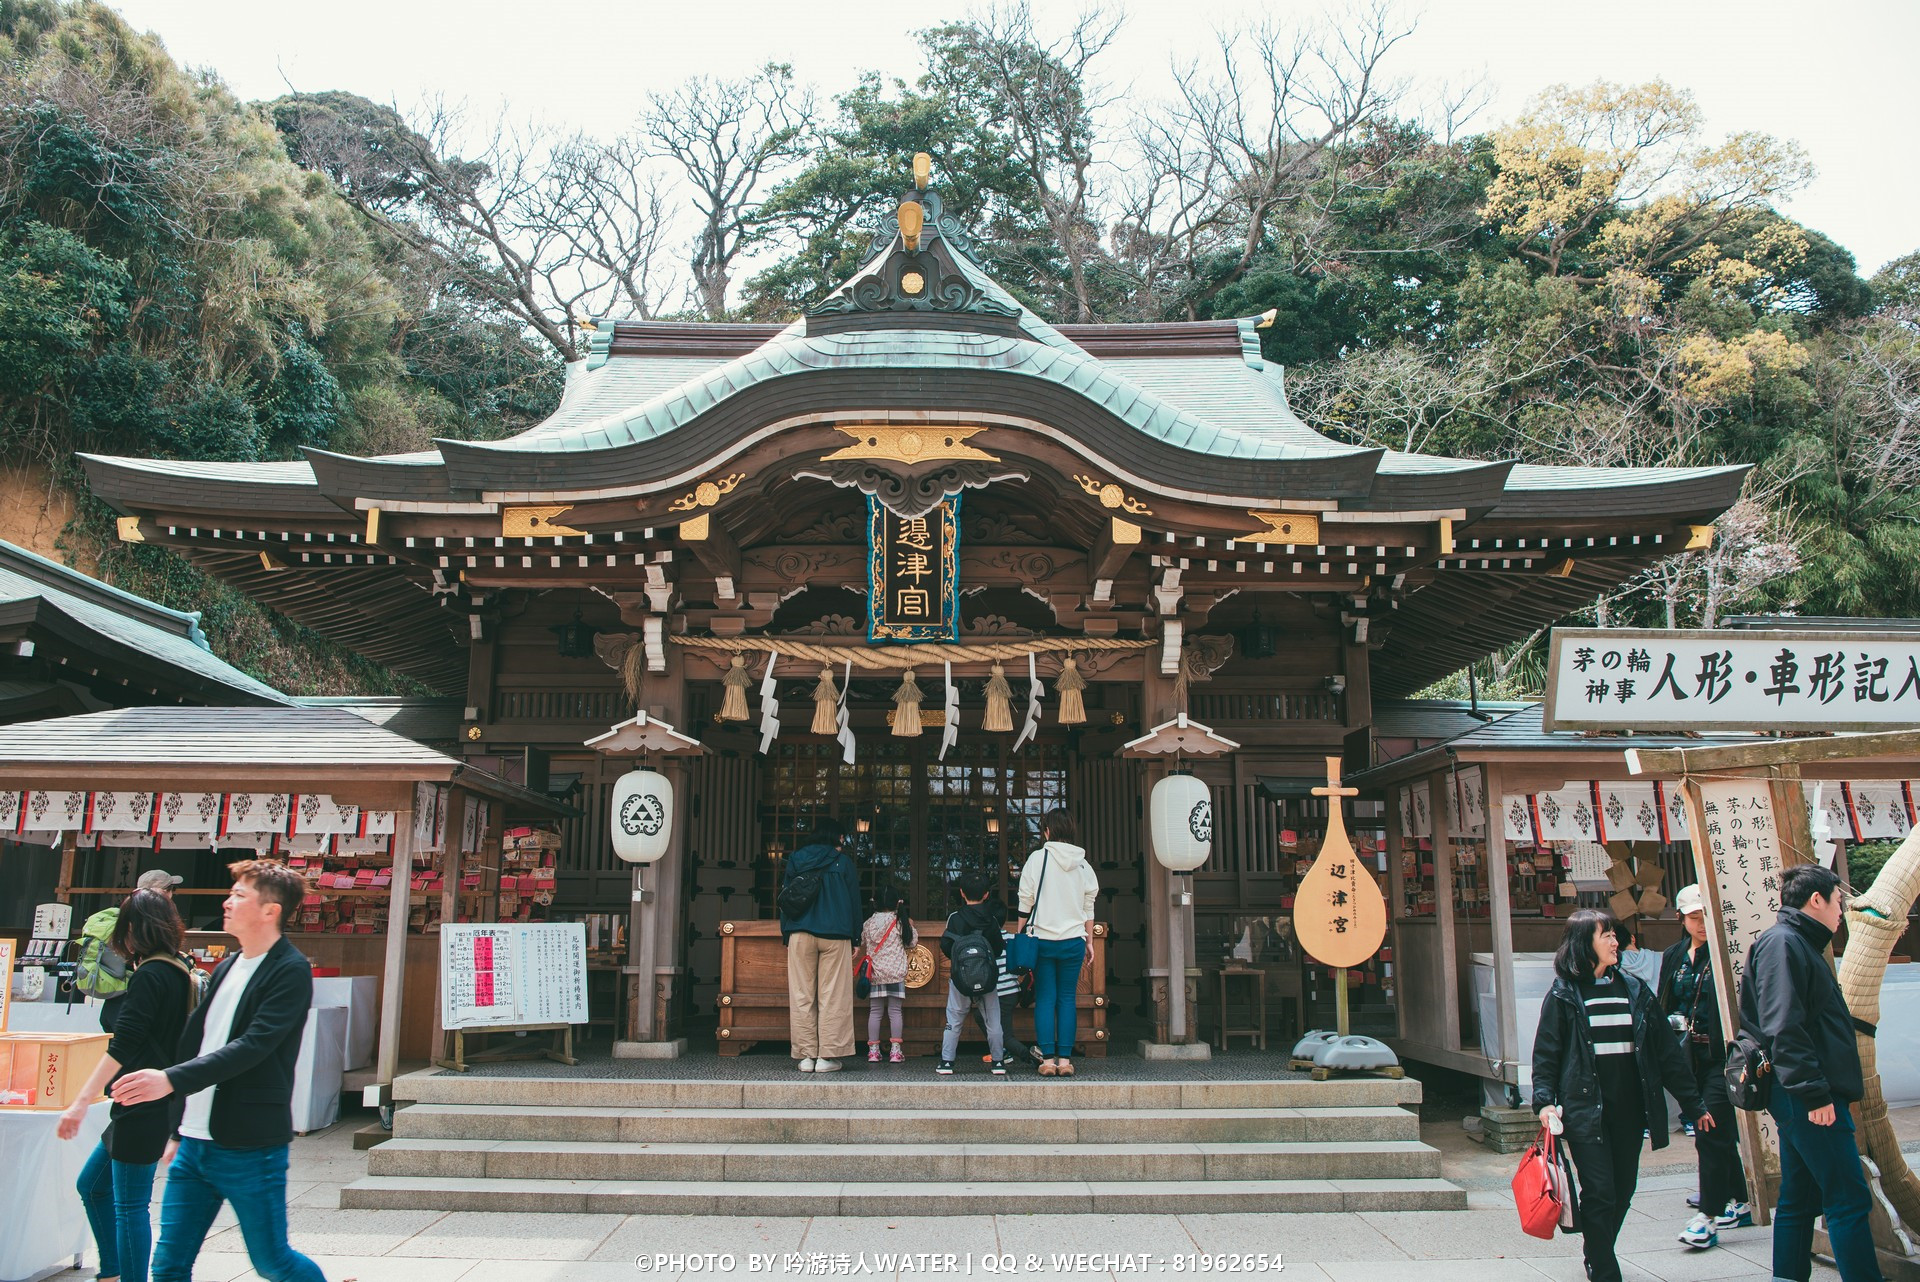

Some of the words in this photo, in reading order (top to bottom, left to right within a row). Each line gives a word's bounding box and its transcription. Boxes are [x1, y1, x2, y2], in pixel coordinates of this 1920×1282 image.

[1572, 648, 1652, 673] 茅の輪
[1584, 678, 1637, 704] 神事
[1330, 864, 1349, 933] 辺津宮
[45, 1052, 59, 1097] おみくじ
